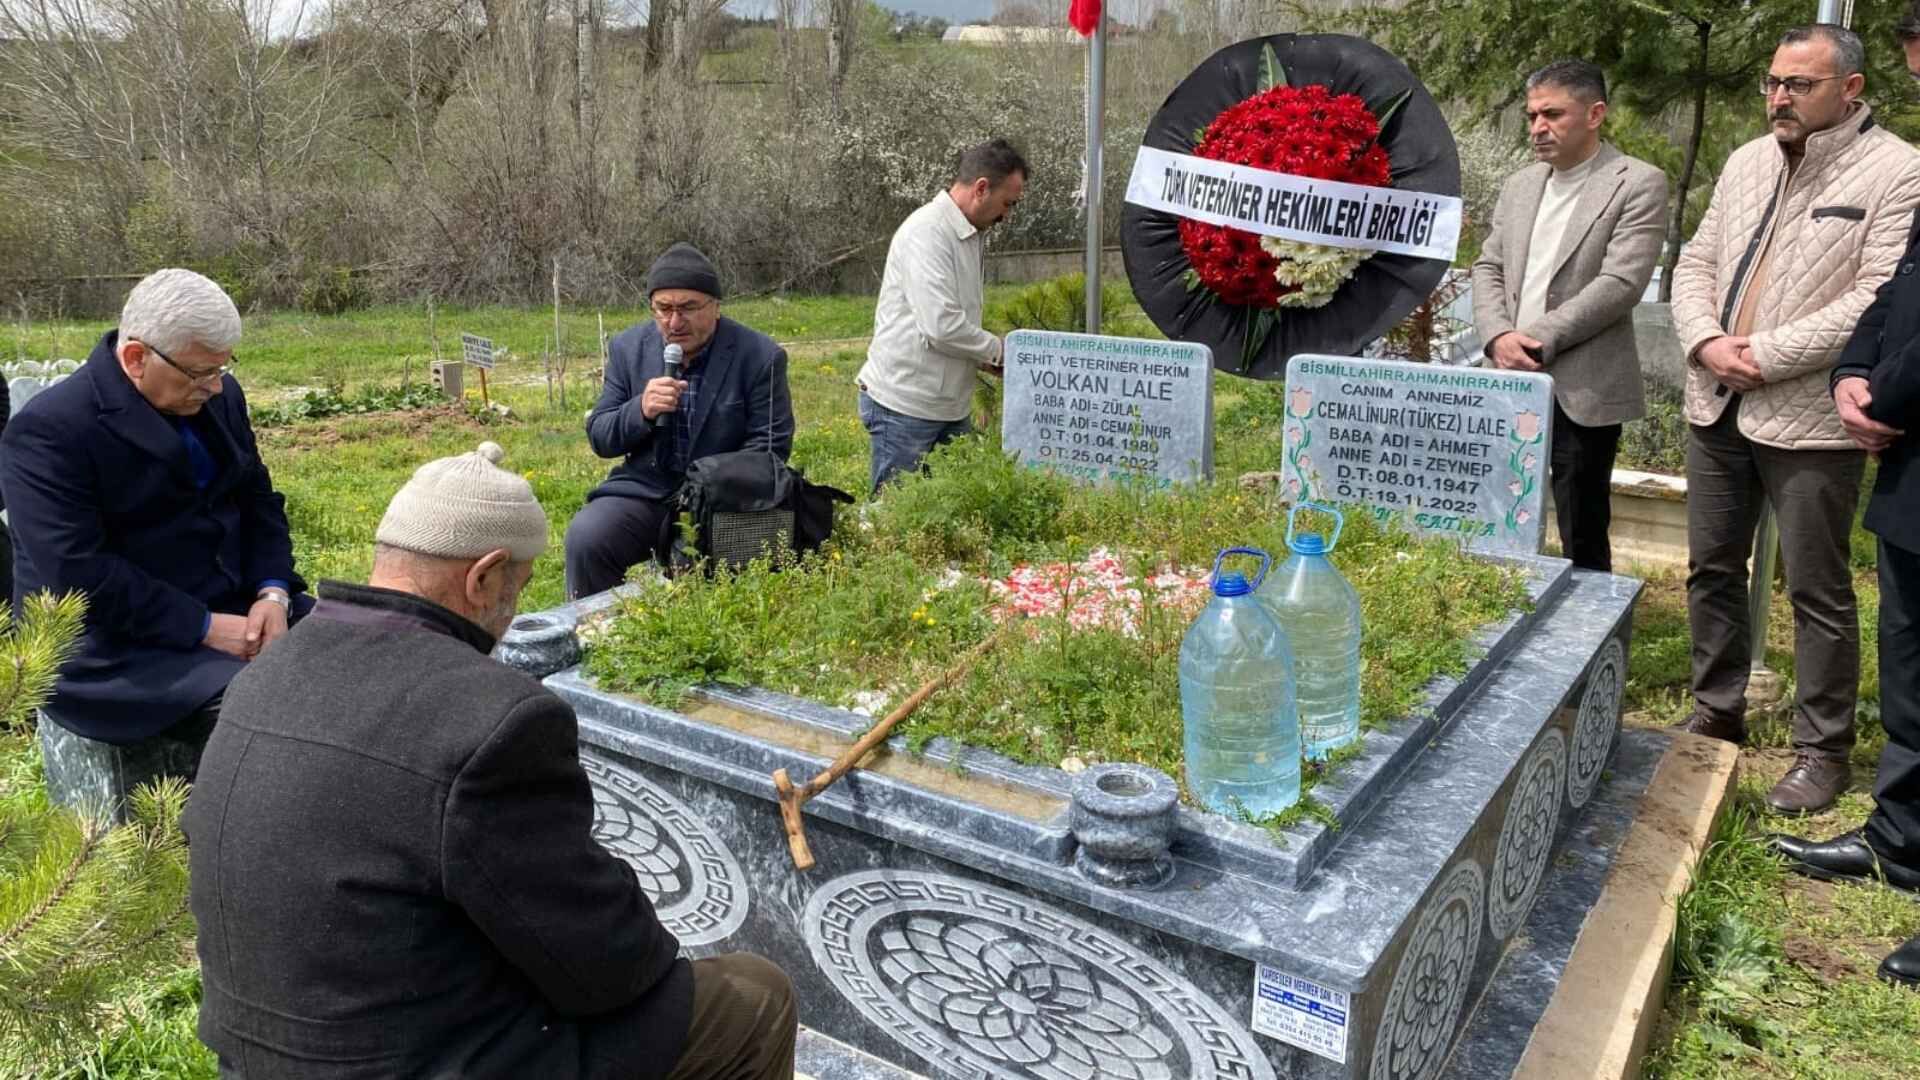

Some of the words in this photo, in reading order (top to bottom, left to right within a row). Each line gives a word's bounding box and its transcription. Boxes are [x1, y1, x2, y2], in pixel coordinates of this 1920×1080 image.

[1161, 161, 1188, 206] TÜRK
[1187, 171, 1263, 222] VETERİNER
[1265, 185, 1368, 238] HEKİMLERİ
[1366, 196, 1438, 247] BİRLİĞİ
[1017, 351, 1054, 366] ŞEHİT
[1060, 356, 1139, 373] VETERİNER
[1143, 361, 1189, 378] HEKİM
[1030, 369, 1109, 394] VOLKAN
[1121, 380, 1173, 401] LALE
[1341, 383, 1393, 399] CANIM
[1406, 389, 1484, 408] ANNEMİZ
[1034, 394, 1065, 408] BABA
[1033, 412, 1064, 427] ANNE
[1468, 416, 1505, 437] LALE
[1330, 427, 1373, 444] BABA
[1428, 438, 1491, 458] AHMET
[1328, 446, 1371, 463] ANNE
[1426, 456, 1492, 478] ZEYNEP
